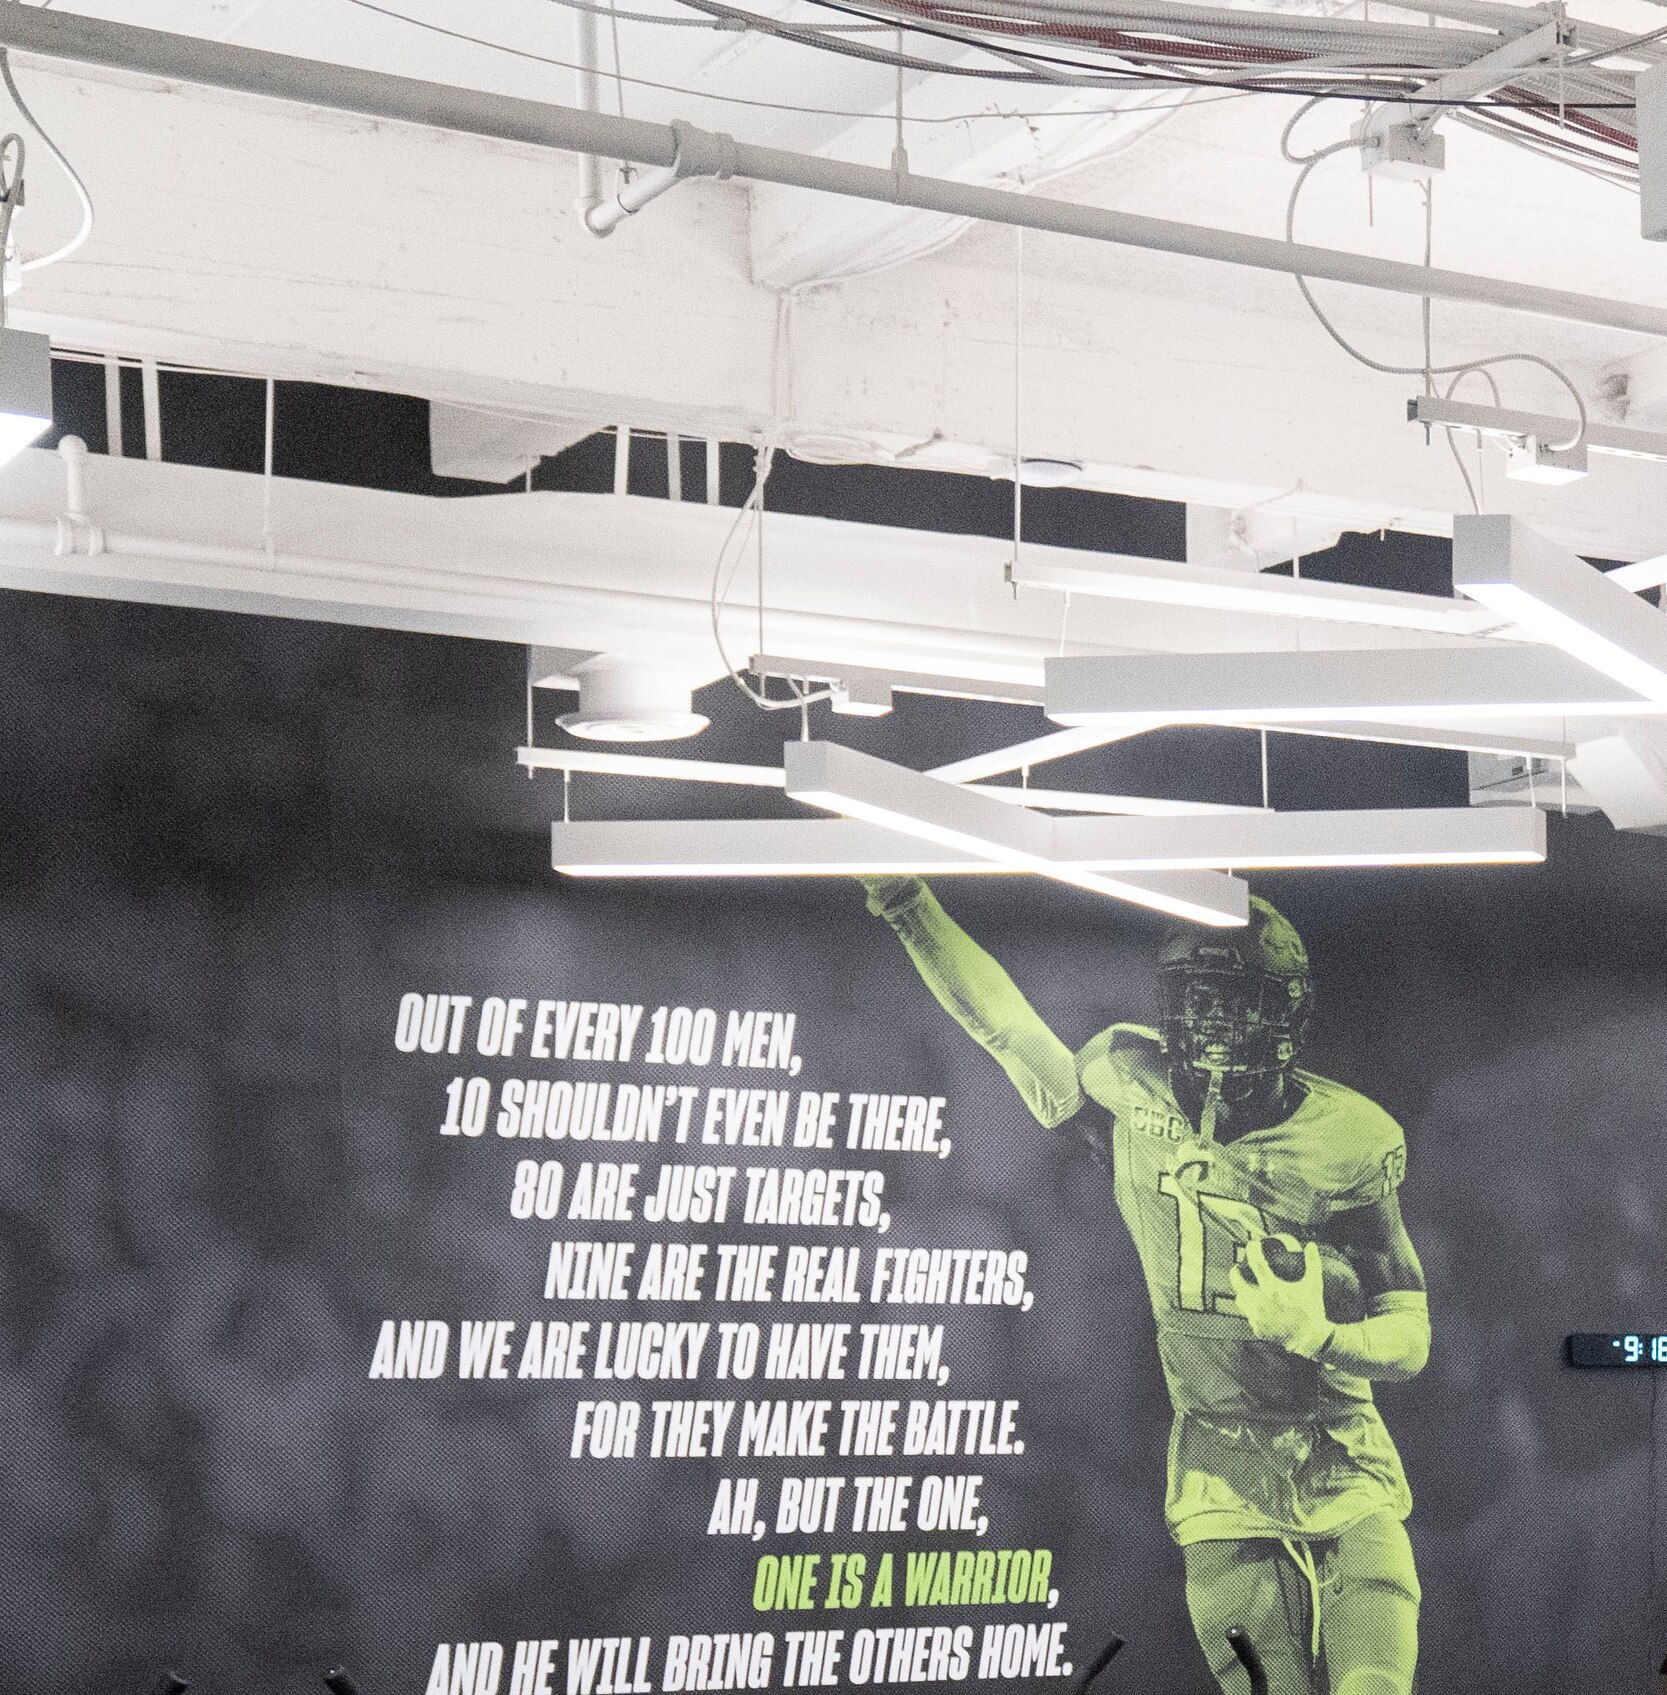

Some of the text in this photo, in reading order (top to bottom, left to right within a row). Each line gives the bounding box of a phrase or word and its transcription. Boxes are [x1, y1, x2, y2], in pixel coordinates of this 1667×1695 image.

[395, 993, 803, 1077] OUT OF EVERY 100 MEN,
[440, 1077, 953, 1159] 10 SHOULDN'T EVEN BE THERE,
[510, 1159, 892, 1234] 80 ARE JUST TARGETS,
[544, 1241, 1034, 1312] NINE ARE THE REAL FIGHTERS,
[369, 1320, 950, 1386] AND WE ARE LUCKY TO HAVE THEM,
[570, 1400, 1024, 1458] FOR THEY MAKE THE BATTLE.
[707, 1475, 988, 1541] AH, BUT THE ONE,
[753, 1549, 1059, 1611] ONE IS A WARRIOR,
[567, 1637, 651, 1695] WILL
[662, 1632, 774, 1692] BRING
[783, 1630, 844, 1687] THE
[849, 1625, 973, 1684] OTHERS
[978, 1622, 1073, 1679] HOME.
